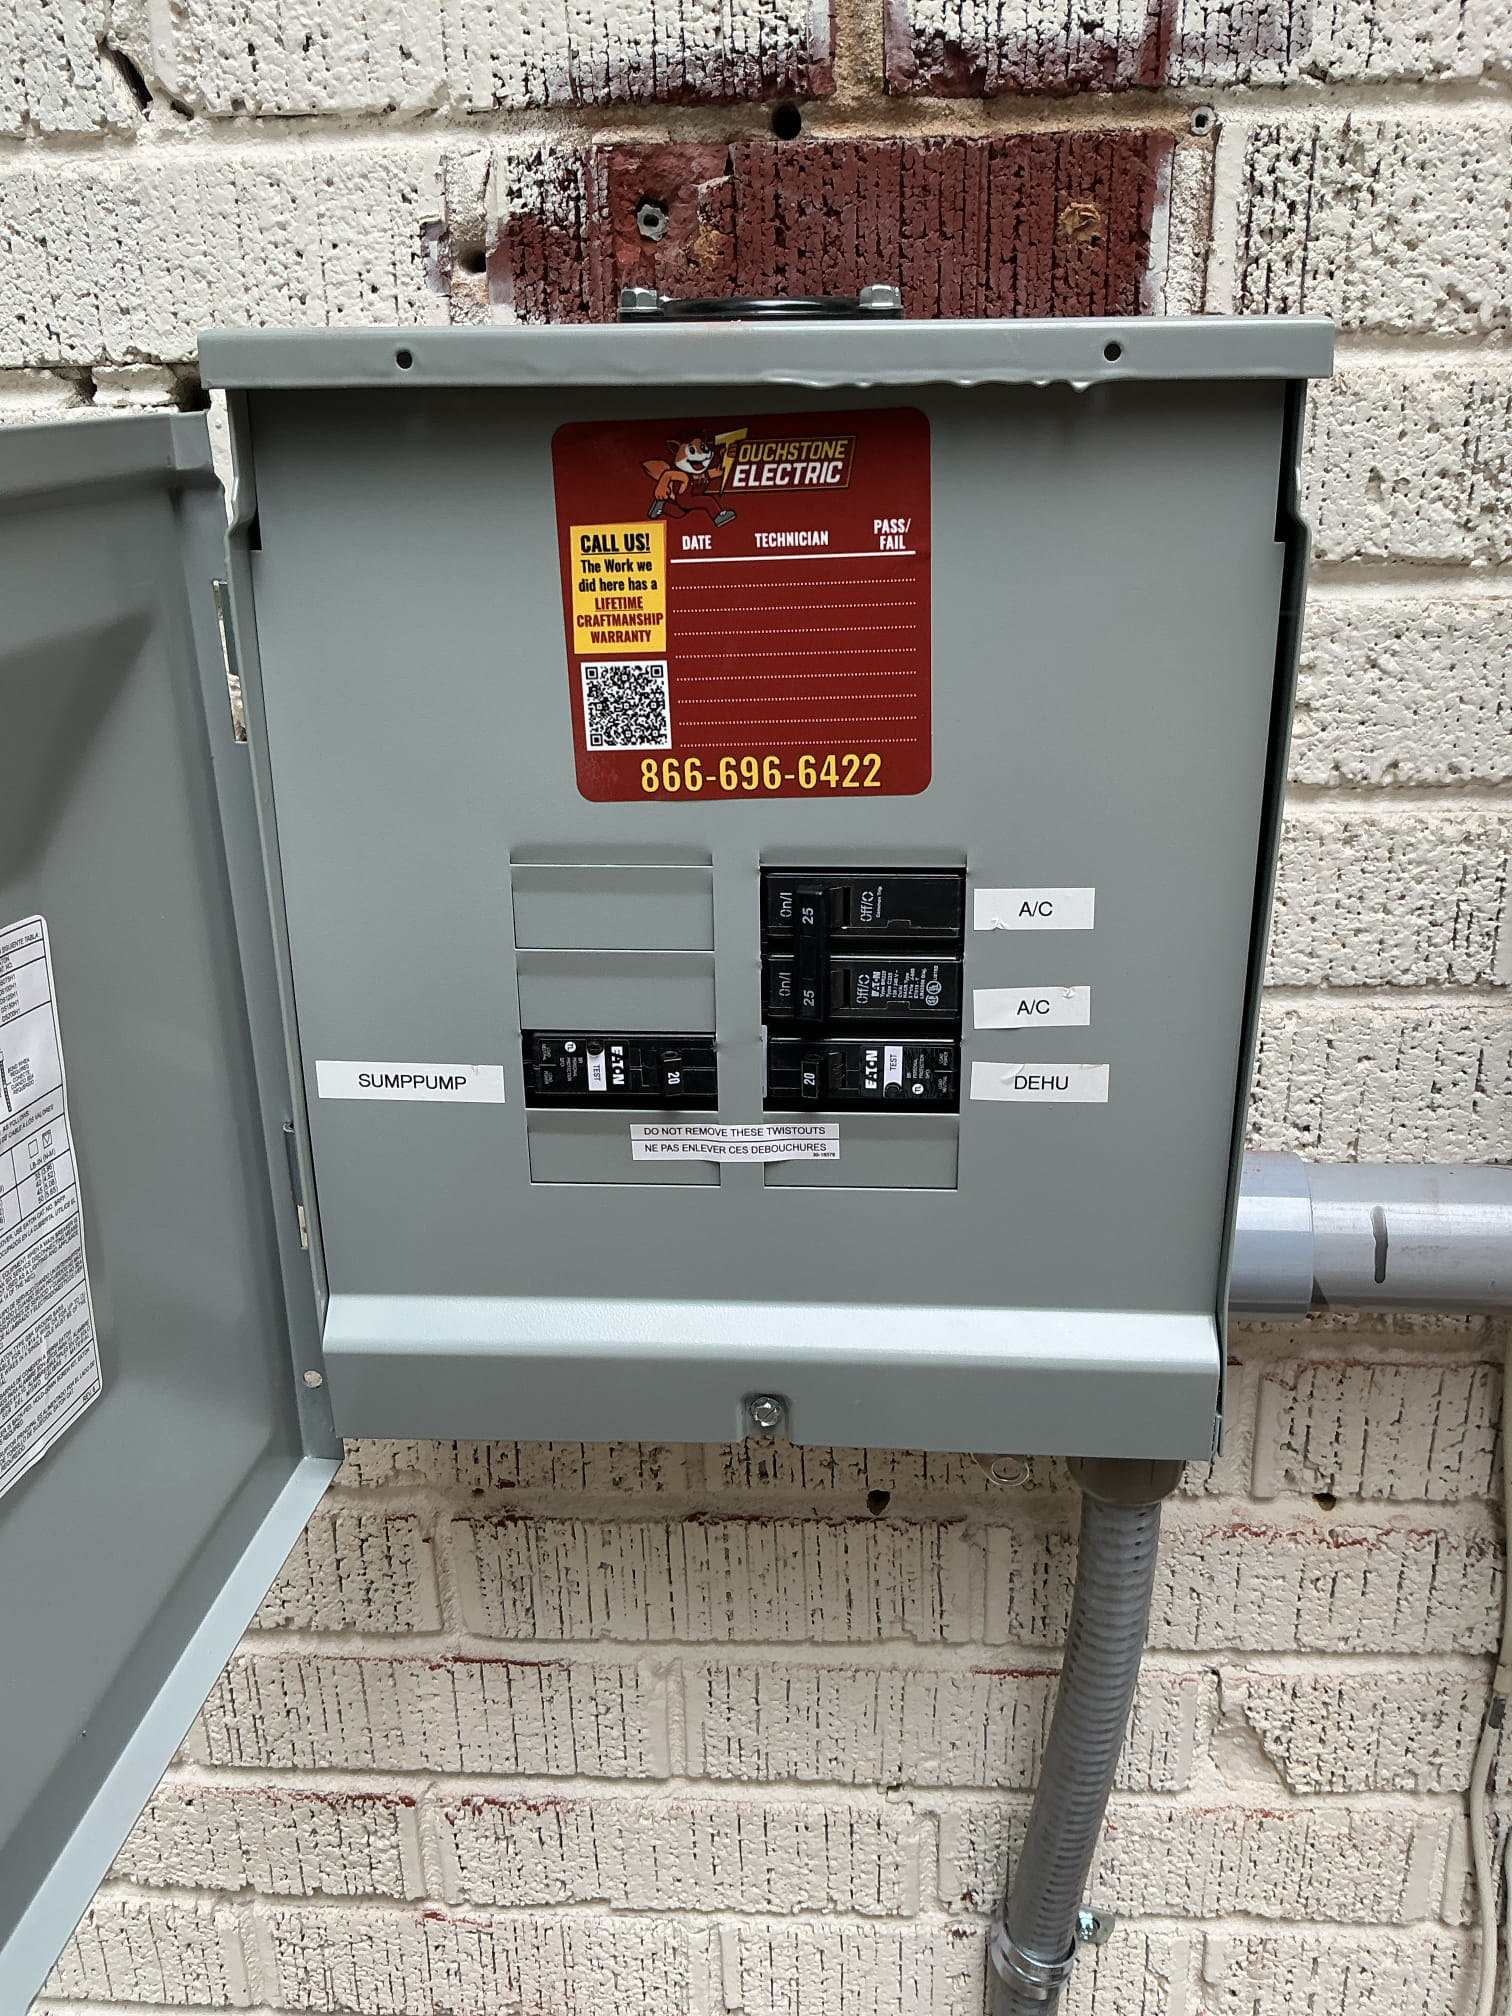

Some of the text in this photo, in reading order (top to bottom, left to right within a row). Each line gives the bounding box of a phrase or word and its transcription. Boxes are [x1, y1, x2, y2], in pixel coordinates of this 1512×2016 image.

[732, 460, 843, 488] ELECTRIC
[873, 518, 912, 535] PASS/
[580, 533, 651, 553] CALL US!
[682, 530, 829, 550] DATE TECHNICIAN
[879, 535, 906, 550] FAIL
[580, 558, 653, 574] The Work we
[578, 576, 658, 592] did here has a
[594, 596, 644, 610] LIFETIME
[576, 612, 664, 628] CRAFTMANSHIP
[590, 630, 652, 644] WARRANTY
[640, 753, 882, 793] 866-696-6422
[802, 907, 814, 925] 25
[1018, 900, 1053, 917] A/C
[803, 990, 815, 1007] 25
[1016, 999, 1050, 1015] A/C
[611, 1046, 625, 1085] EATON
[865, 1050, 878, 1089] EATON
[889, 1053, 897, 1072] TEST
[593, 1064, 601, 1081] TEST
[667, 1071, 681, 1085] 20
[803, 1072, 815, 1086] 20
[358, 1073, 467, 1090] SUMPPUMP
[1014, 1076, 1069, 1091] DEHU
[644, 1126, 826, 1137] DO NOT REMOVE THESE TWISTOUTS
[645, 1143, 827, 1154] NE PAS ENLEVER CES DEBOUCHURES
